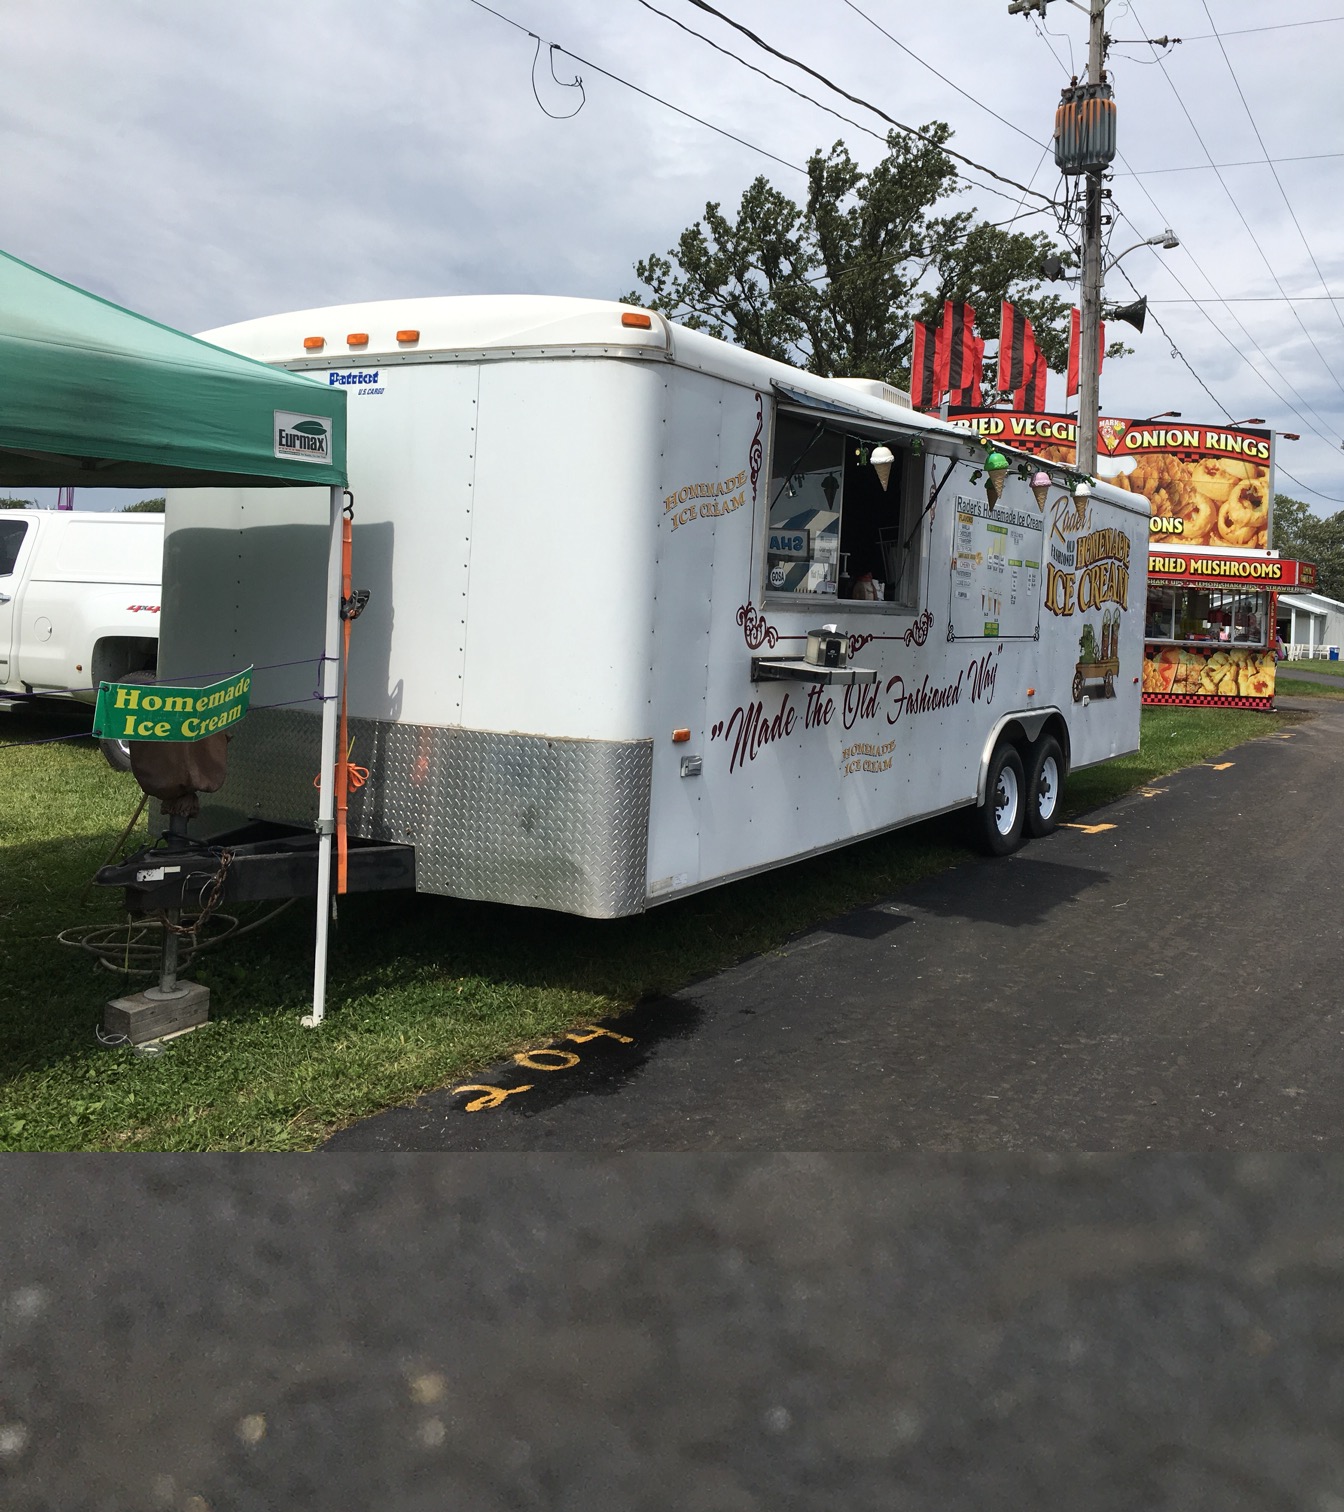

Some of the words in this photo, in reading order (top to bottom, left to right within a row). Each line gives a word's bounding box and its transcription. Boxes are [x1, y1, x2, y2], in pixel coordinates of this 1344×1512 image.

[329, 370, 379, 385] Patriot
[367, 387, 385, 395] CARGO
[278, 428, 325, 452] Eurmax
[1010, 417, 1078, 442] VEGGI
[1125, 429, 1200, 450] ONION
[1205, 431, 1269, 459] RINGS
[663, 470, 748, 515] HOMEMADE
[671, 506, 697, 532] ICE
[699, 490, 746, 518] CREAM
[957, 496, 982, 515] Rader's
[983, 505, 1016, 523] Homemade
[1017, 511, 1026, 525] Ice
[1026, 514, 1043, 531] Cream
[1051, 544, 1075, 567] FASHIONED
[1066, 540, 1075, 553] OLD
[1075, 527, 1131, 571] HOMEMADE
[1149, 556, 1186, 574] FRIED
[1189, 558, 1282, 579] MUSHROOMS
[1044, 562, 1076, 617] ICE
[1078, 561, 1129, 613] CREAM
[113, 676, 250, 712] Homemade
[805, 683, 836, 730] the
[842, 681, 881, 730] Old
[885, 669, 964, 725] Fashioned
[123, 715, 171, 737] Ice
[181, 704, 242, 737] Cream
[841, 740, 896, 763] HOMEMADE
[843, 759, 862, 777] ICE
[862, 756, 893, 774] CREAM
